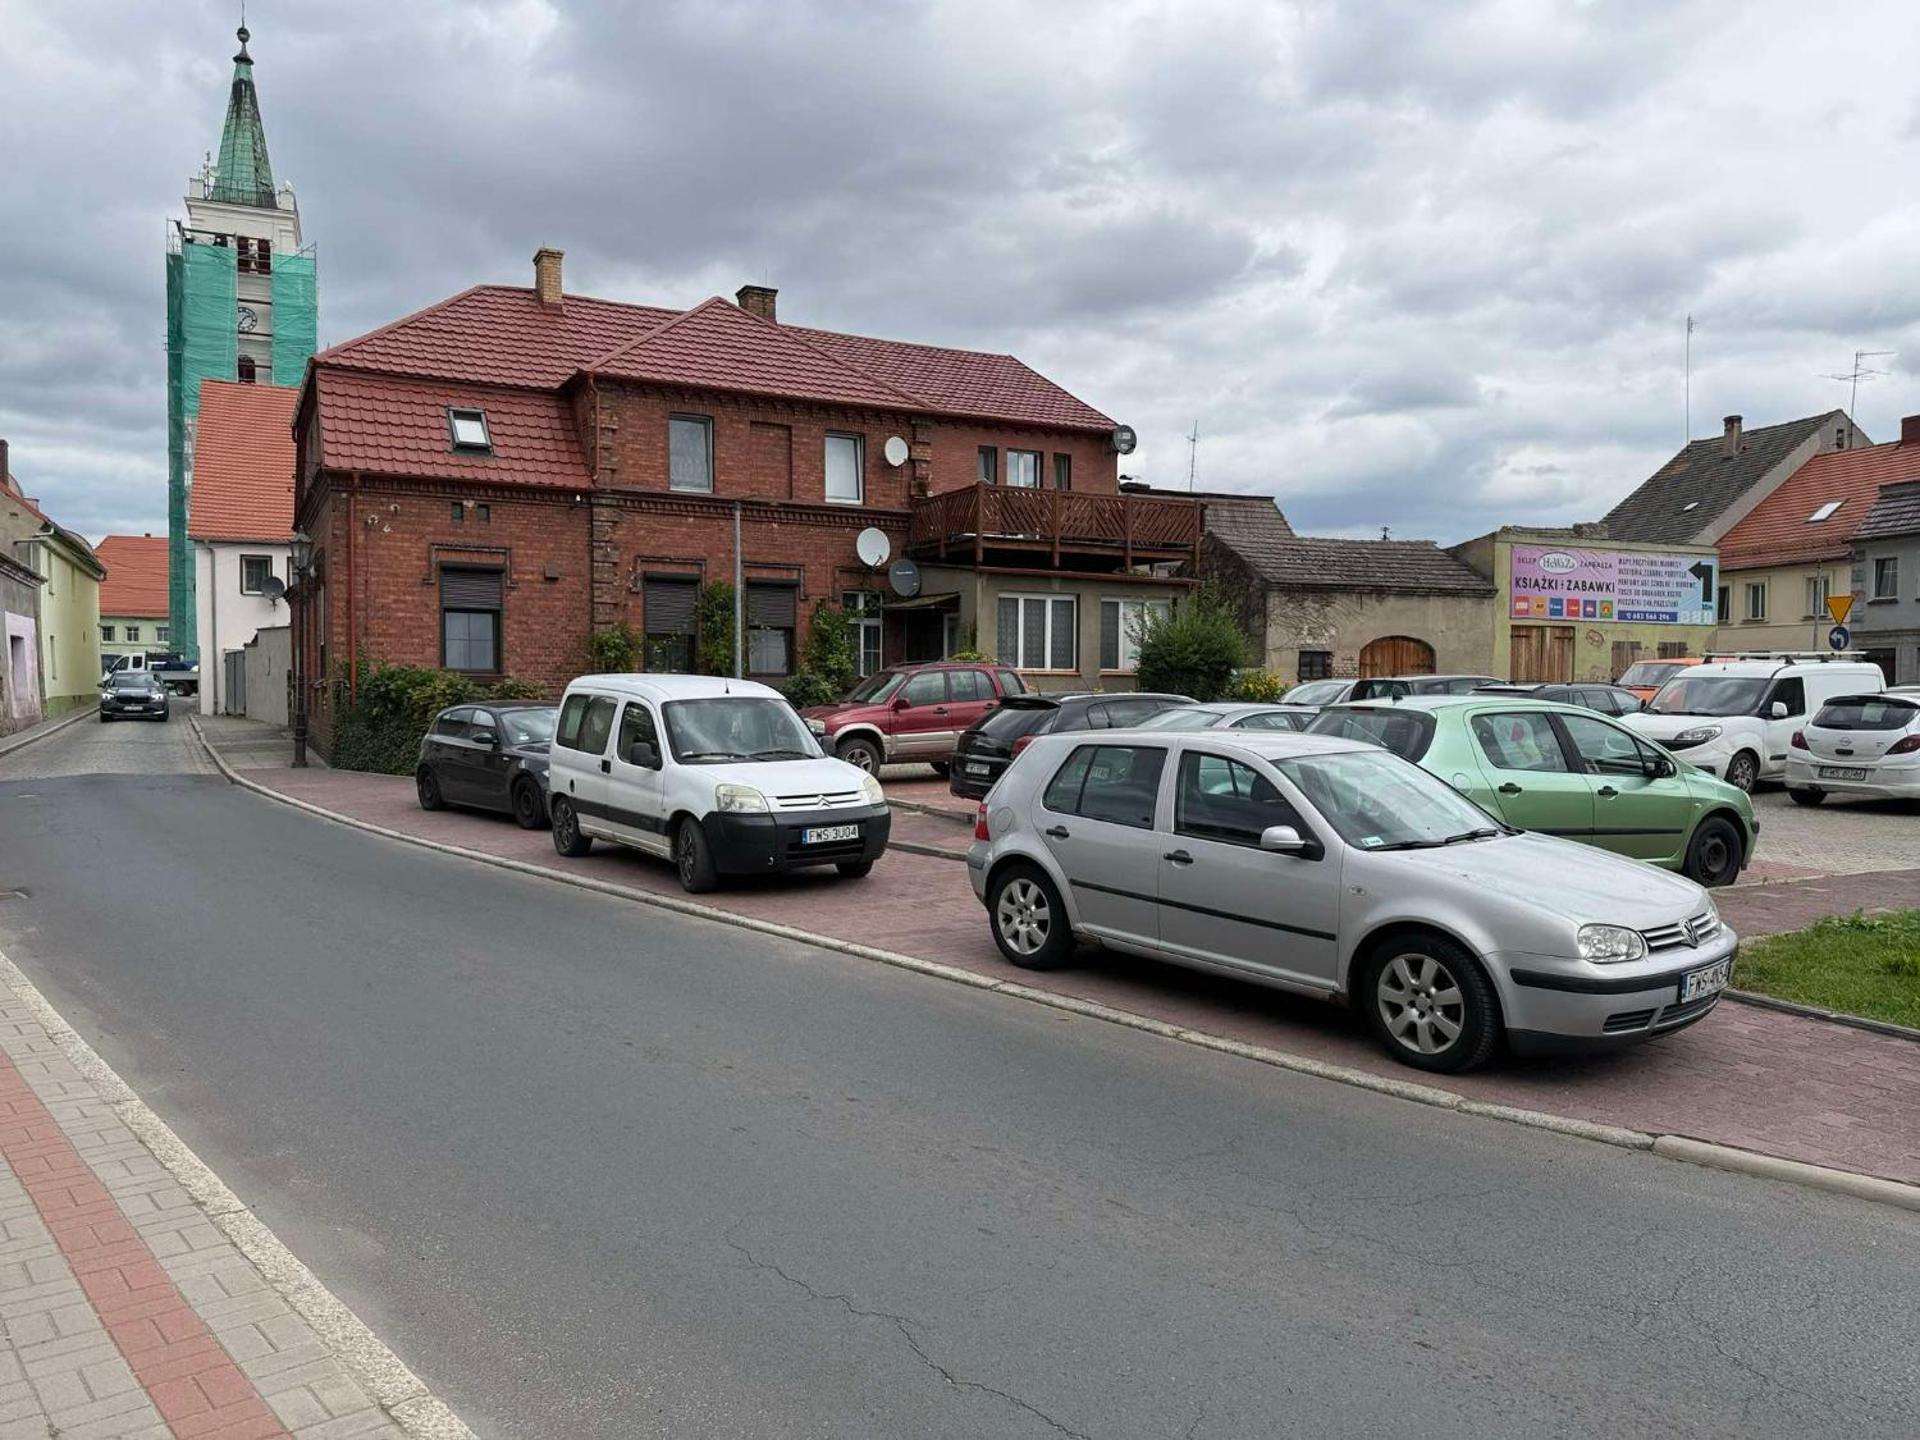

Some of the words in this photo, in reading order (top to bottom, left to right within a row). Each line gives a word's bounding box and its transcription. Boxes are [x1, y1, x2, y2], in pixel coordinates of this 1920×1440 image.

[1518, 556, 1537, 564] SKLEP
[1580, 560, 1612, 569] ZAPRASZA
[1515, 575, 1558, 592] KSIĄŻKI
[1566, 579, 1615, 593] ZABAWKI
[808, 829, 829, 842] FWS
[832, 827, 857, 839] 3U04
[1689, 972, 1707, 993] FWS
